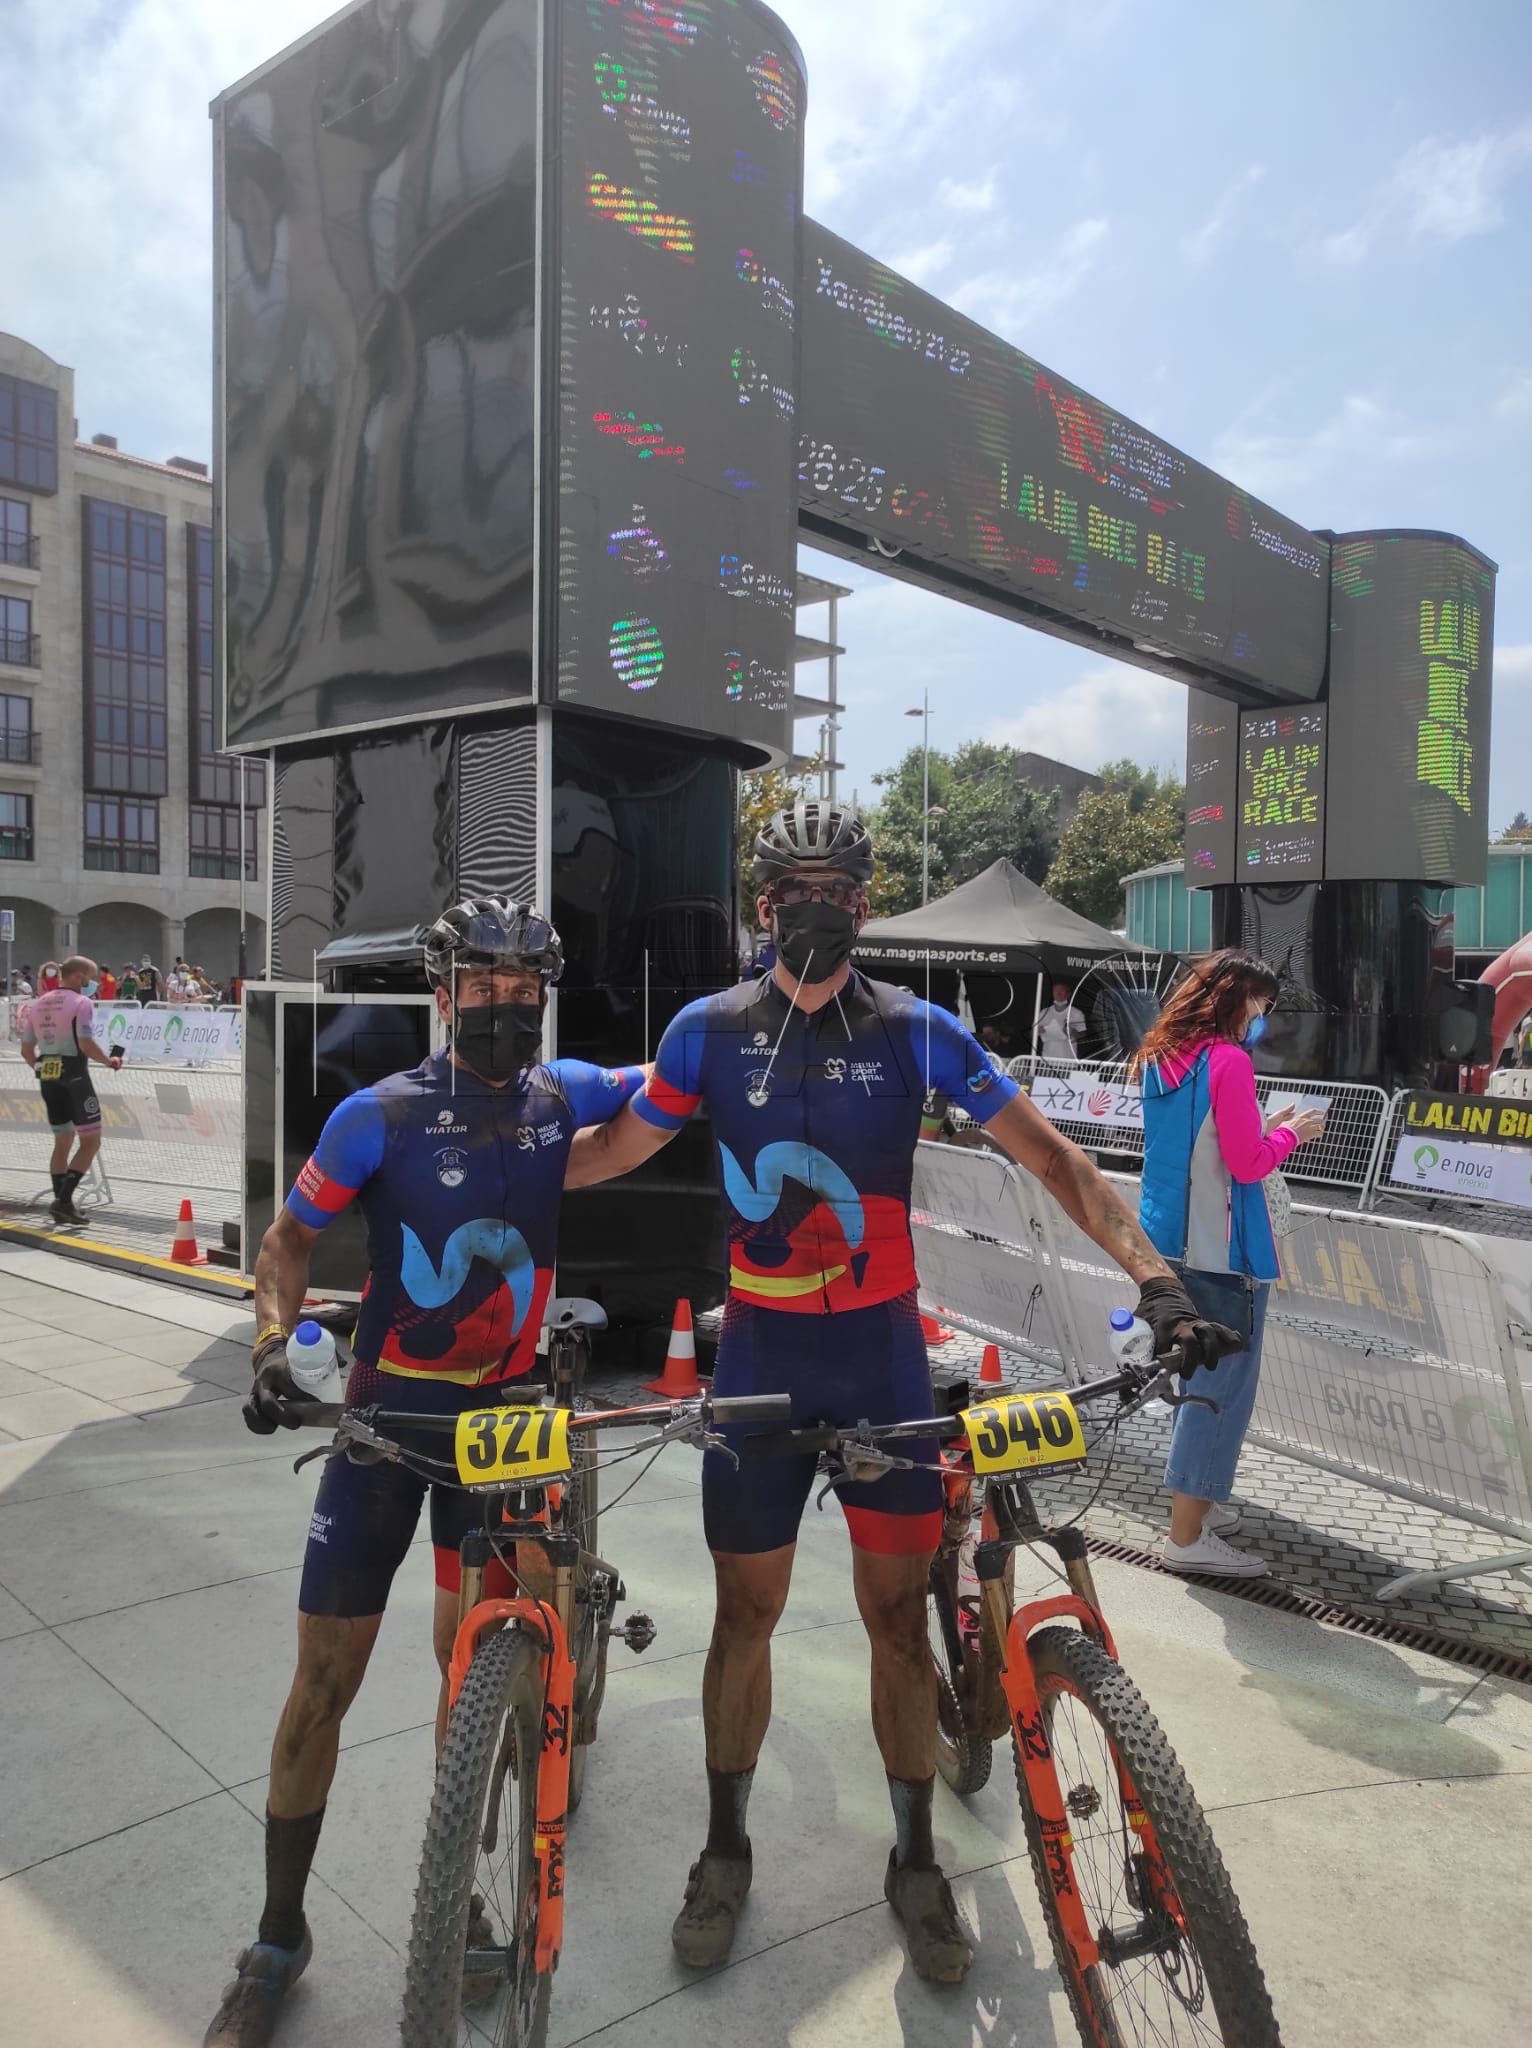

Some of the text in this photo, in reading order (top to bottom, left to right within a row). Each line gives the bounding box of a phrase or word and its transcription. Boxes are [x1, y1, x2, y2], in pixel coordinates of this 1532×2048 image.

[1243, 794, 1319, 827] RACE
[740, 1047, 779, 1056] VIATOR
[851, 1061, 882, 1069] MELILLA
[425, 1124, 468, 1134] VIATOR
[537, 1120, 561, 1134] MELILLA
[1407, 1101, 1493, 1135] LALIN
[467, 1409, 558, 1470] 327
[968, 1396, 1074, 1459] 346
[1043, 1838, 1073, 1896] FOX
